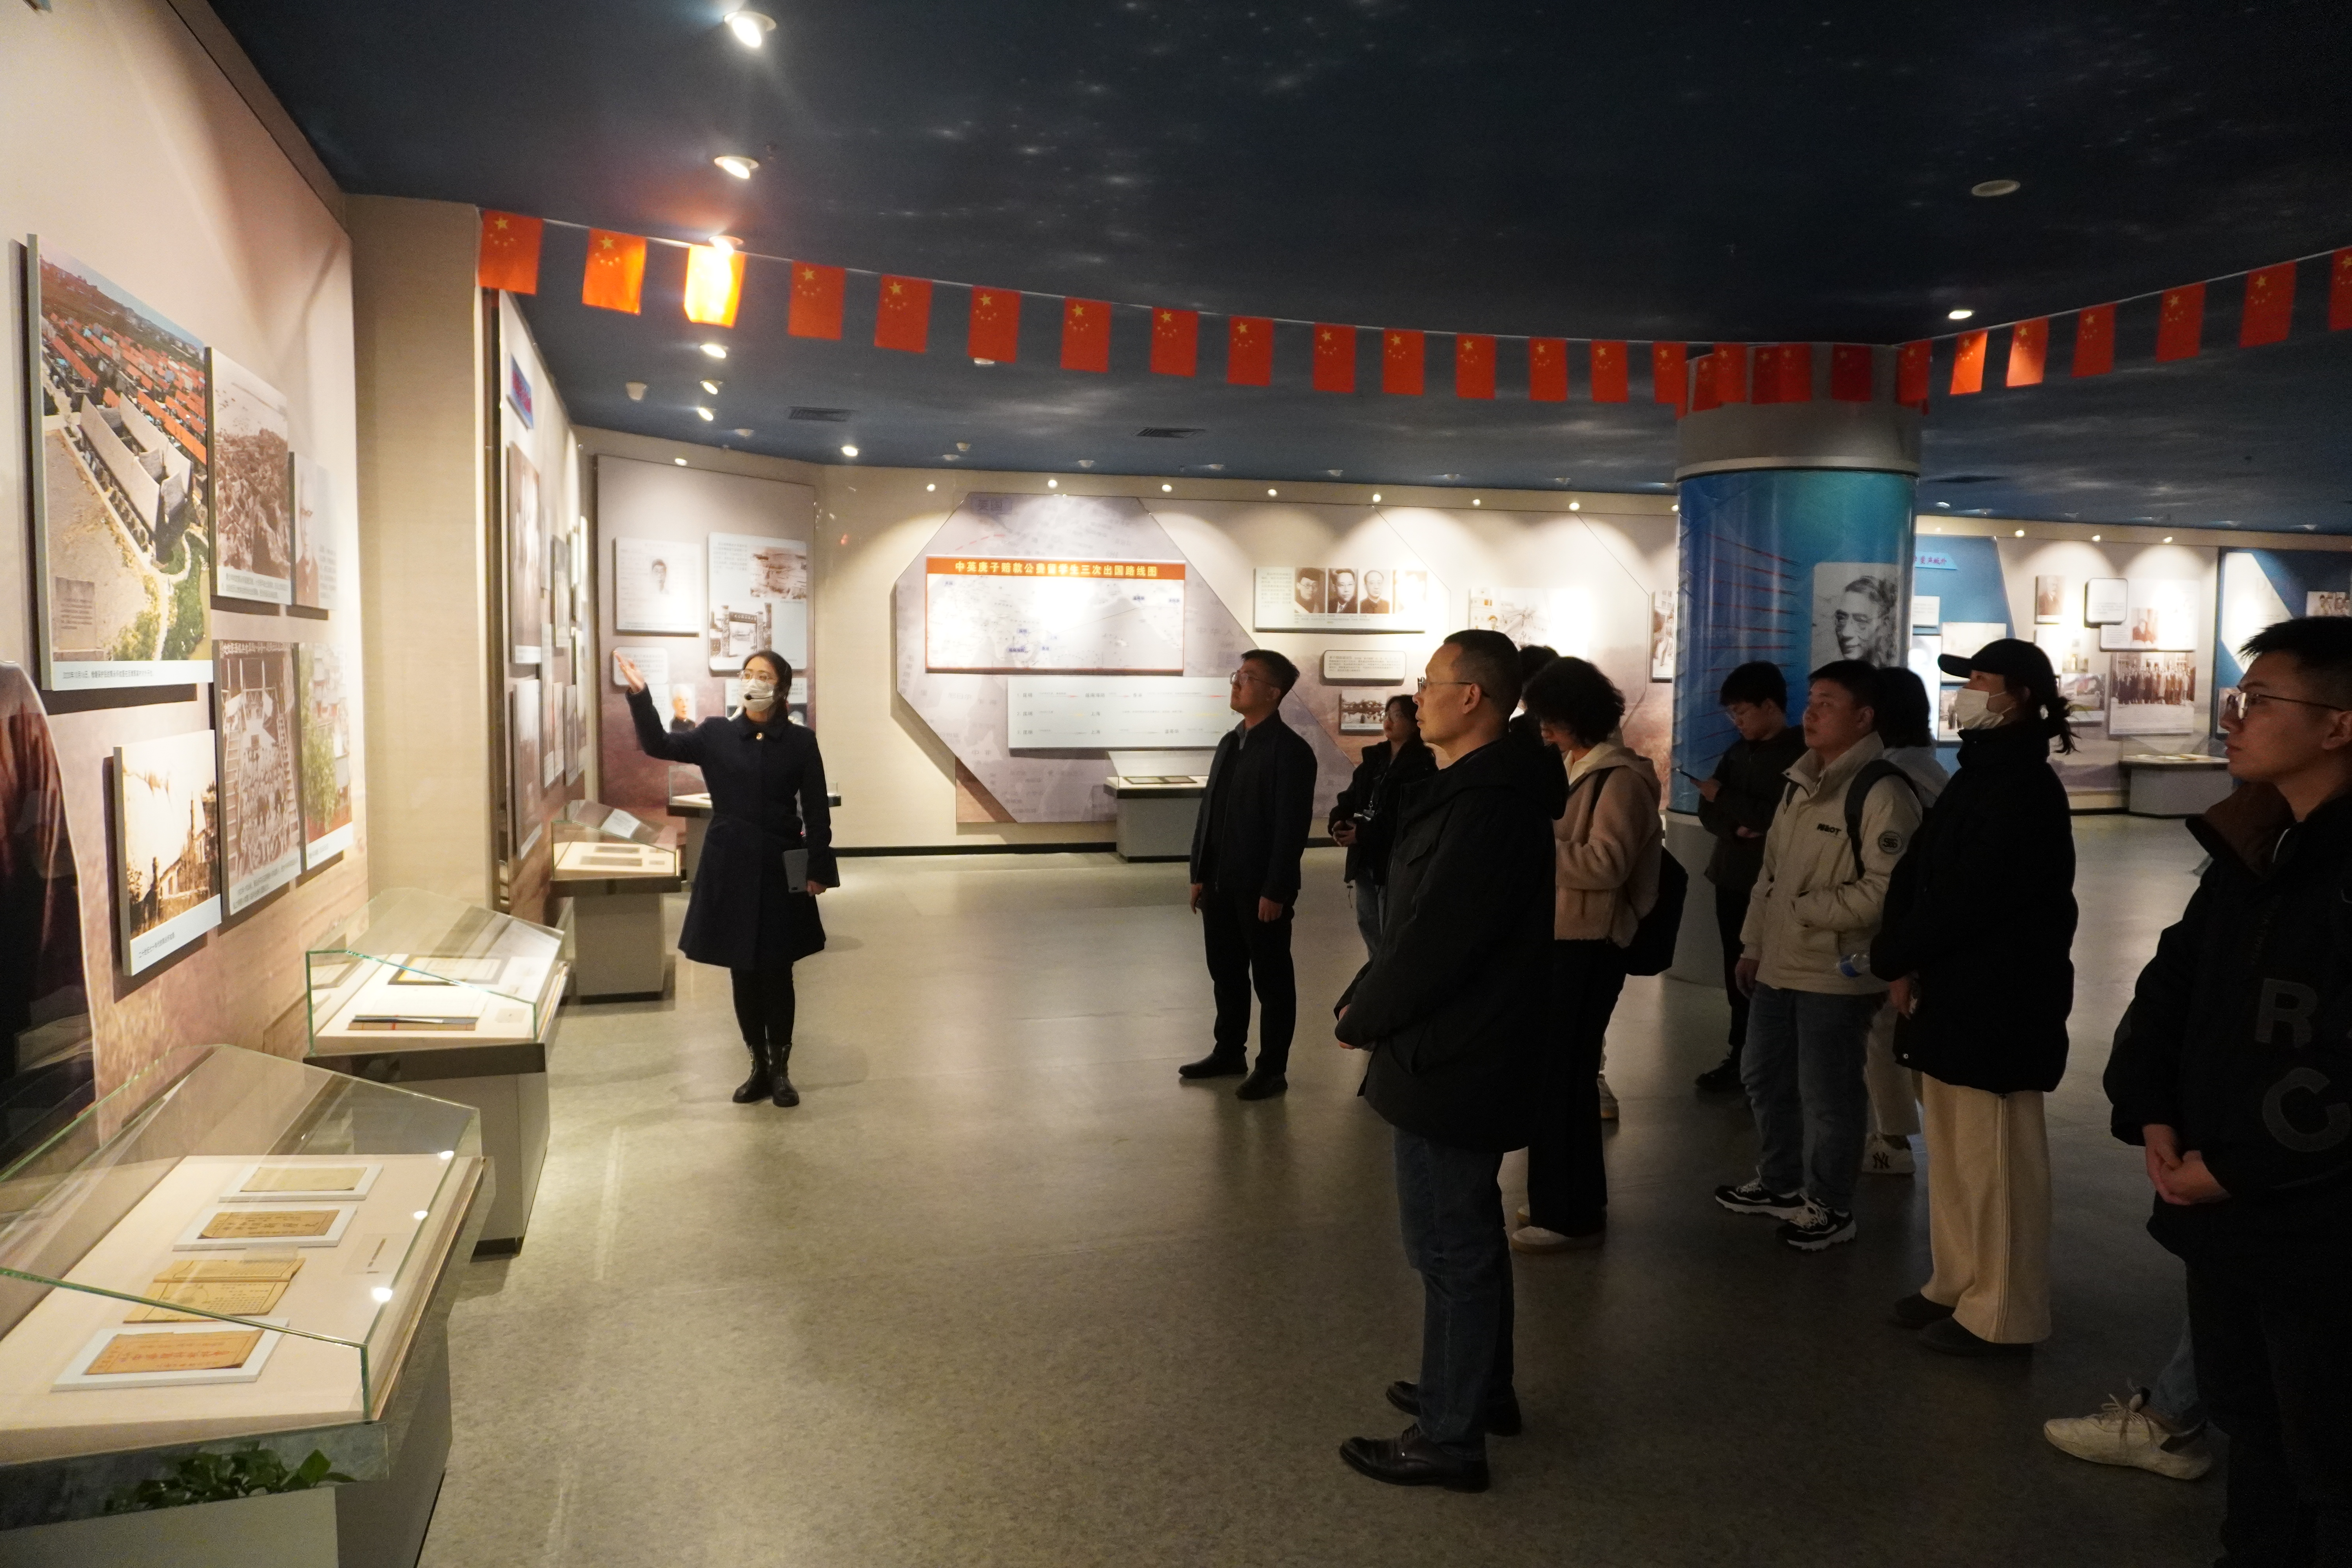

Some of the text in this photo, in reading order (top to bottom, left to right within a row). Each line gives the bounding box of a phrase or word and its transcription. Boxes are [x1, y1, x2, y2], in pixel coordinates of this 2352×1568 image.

[955, 561, 1158, 577] 中英庚子赔款公费留学生三次出国路线图
